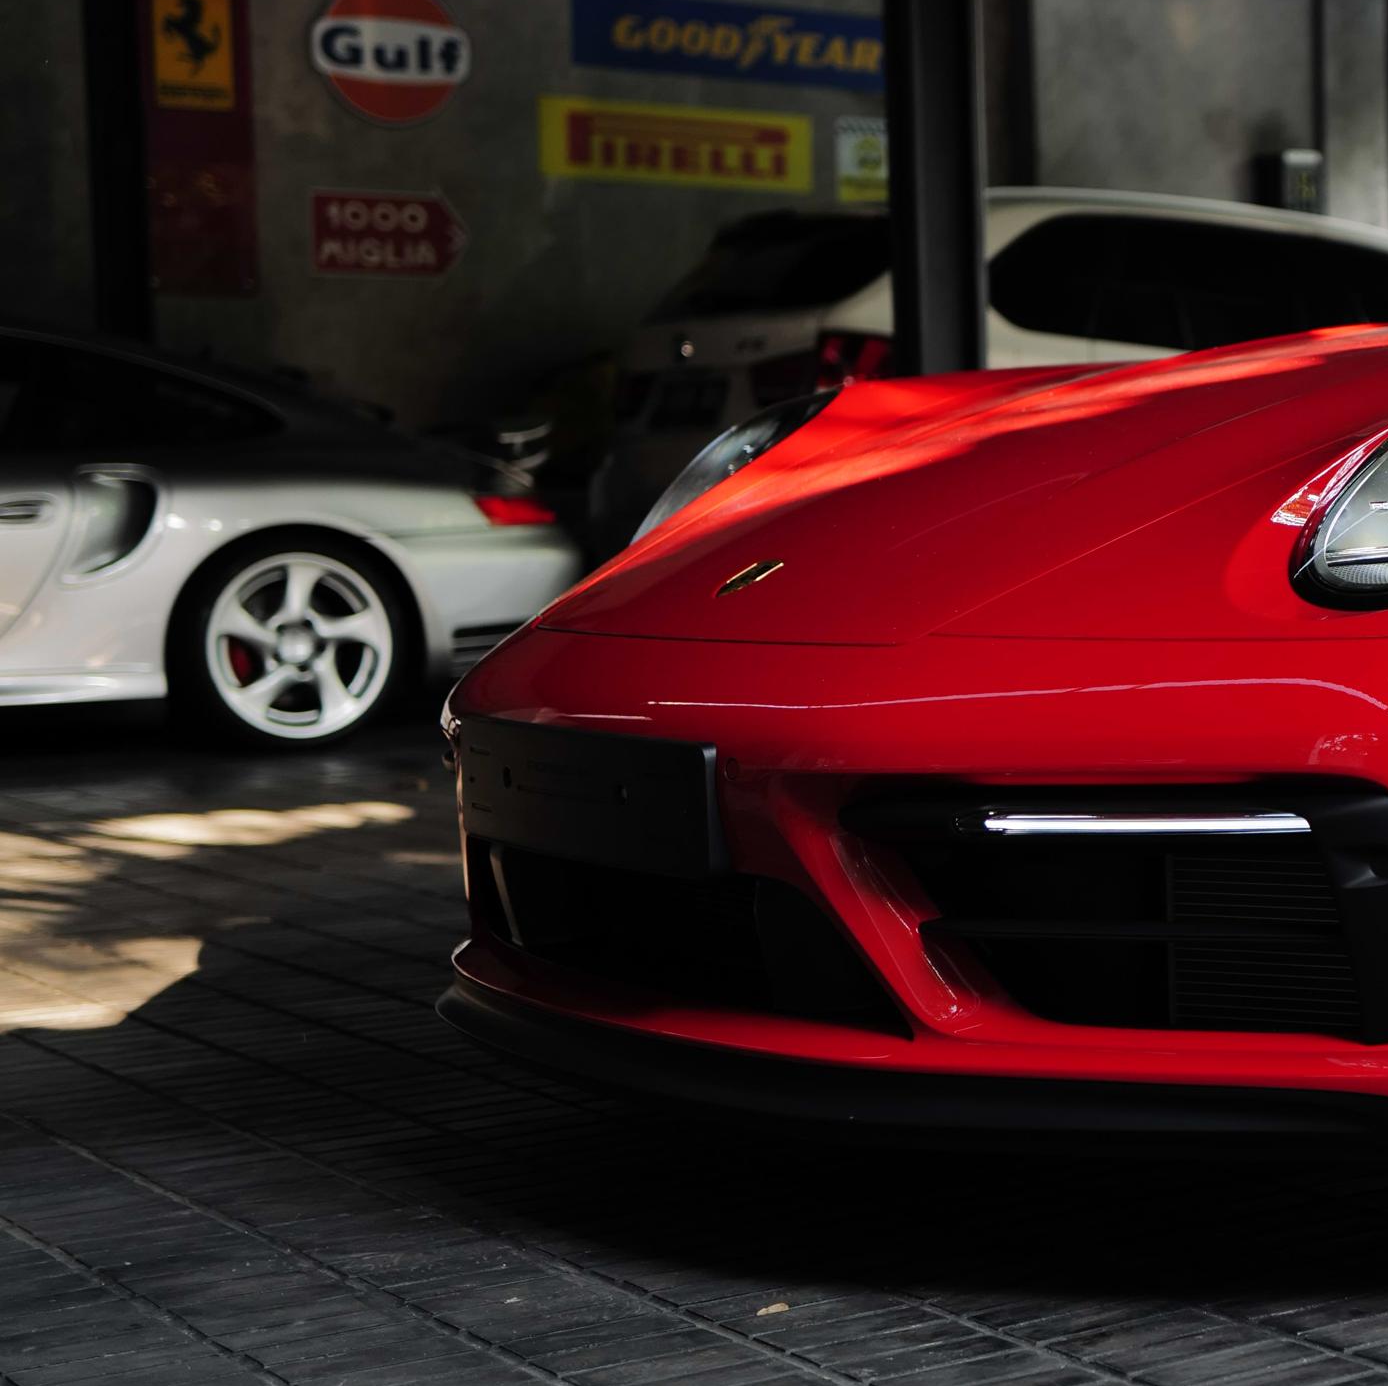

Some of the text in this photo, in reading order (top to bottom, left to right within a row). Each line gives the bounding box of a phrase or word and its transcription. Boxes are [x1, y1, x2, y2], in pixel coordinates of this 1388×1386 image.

[321, 25, 462, 72] Gulf
[567, 113, 789, 177] PIRELLI
[325, 200, 429, 233] 1000
[320, 237, 438, 268] MIGLIA
